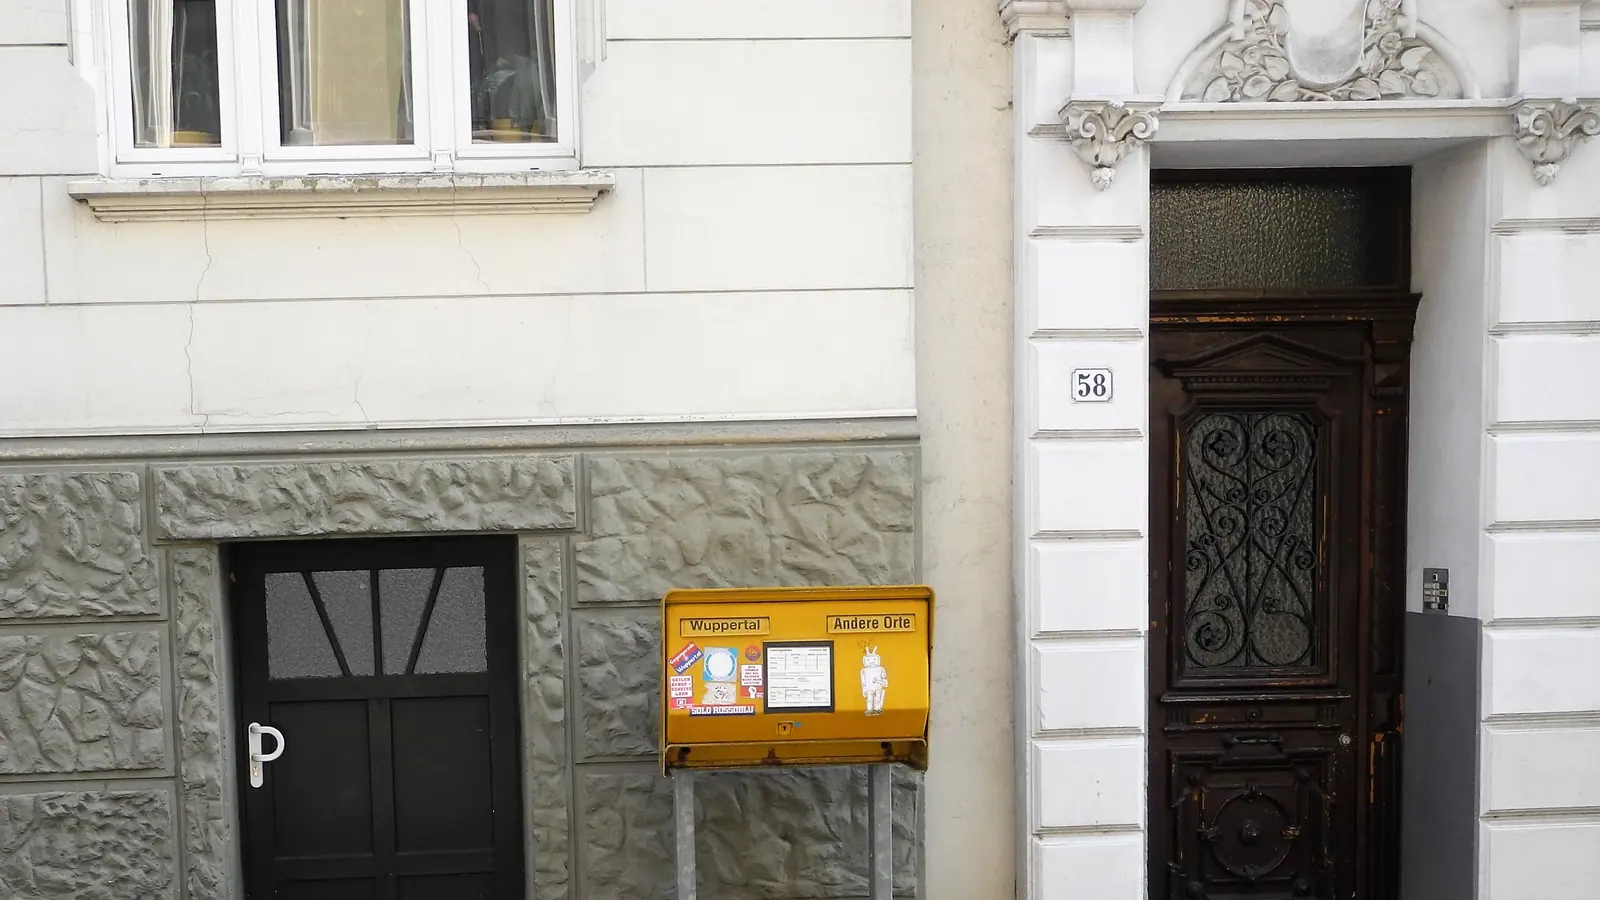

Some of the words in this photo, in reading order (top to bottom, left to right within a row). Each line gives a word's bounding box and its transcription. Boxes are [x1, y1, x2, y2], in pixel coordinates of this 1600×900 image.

[1078, 373, 1106, 397] 58
[690, 620, 760, 633] Wuppertal
[834, 617, 879, 630] Andere
[884, 616, 910, 629] Orte
[676, 650, 702, 673] Wuppertal
[691, 706, 712, 715] SOLO
